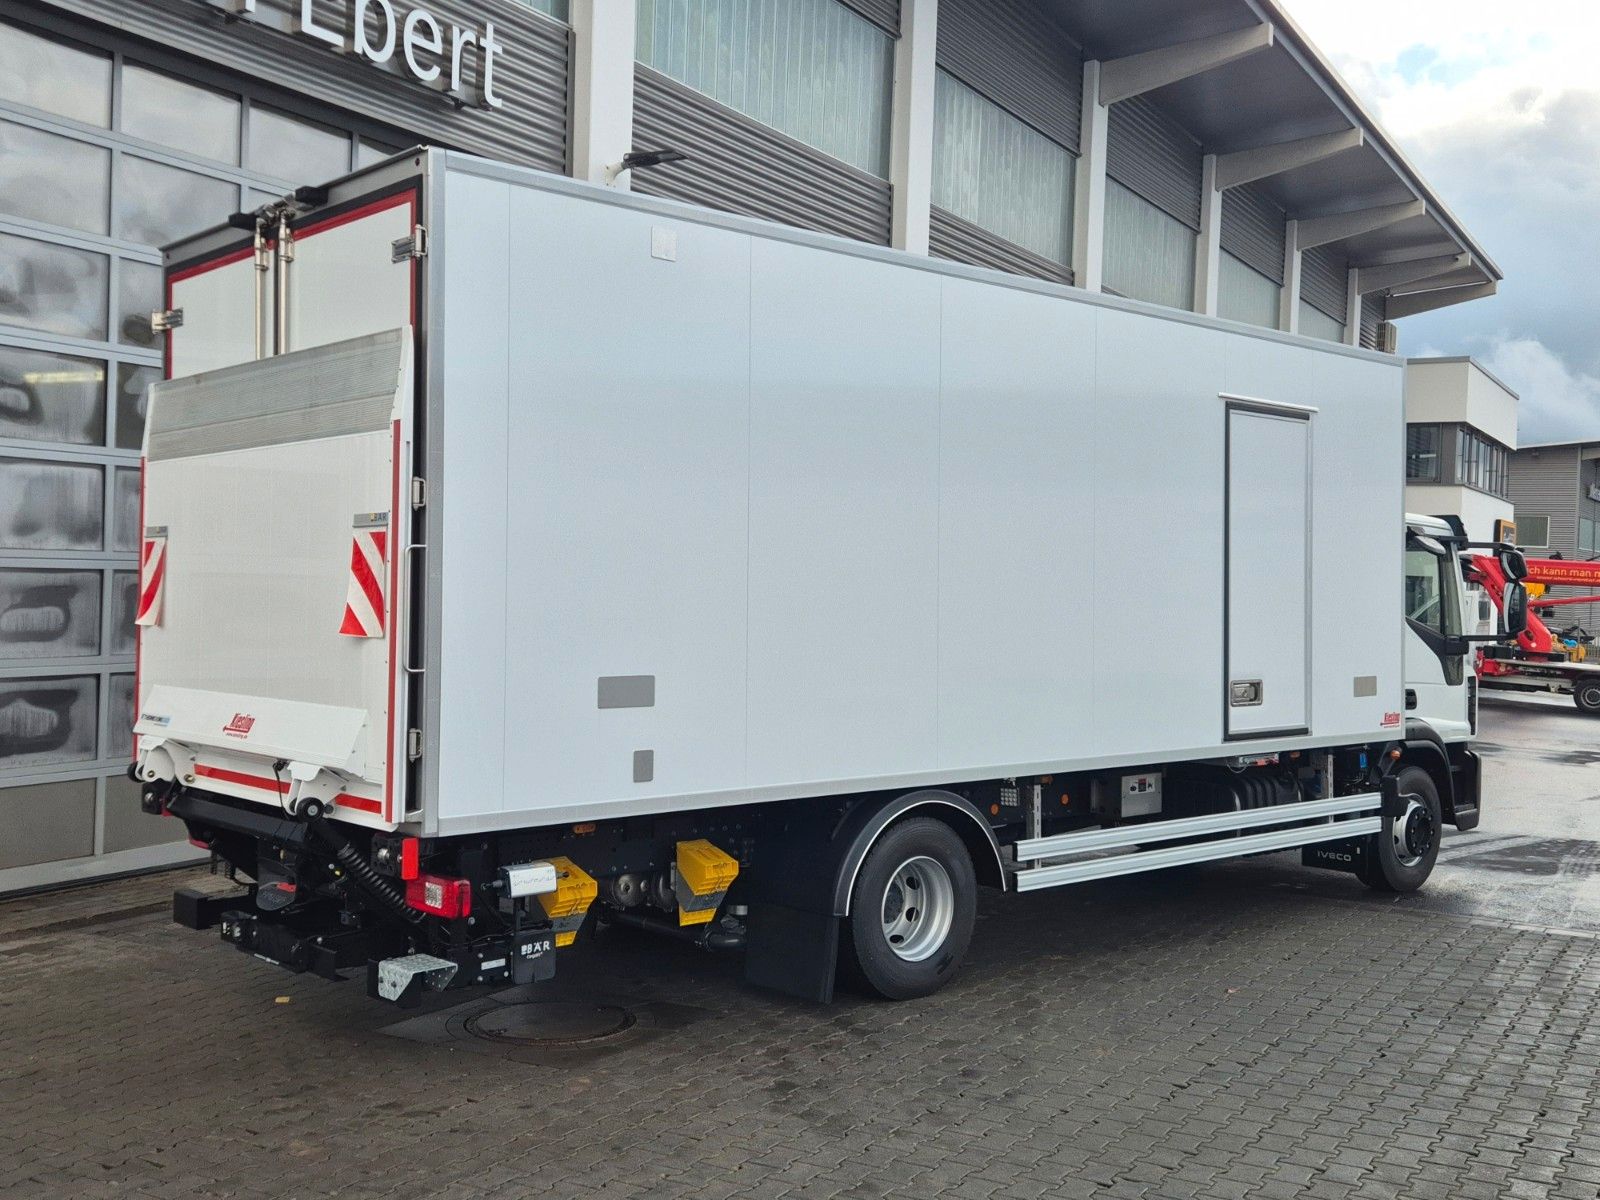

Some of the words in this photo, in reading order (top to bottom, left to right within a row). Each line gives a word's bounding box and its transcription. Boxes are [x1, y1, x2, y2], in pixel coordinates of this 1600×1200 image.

[1543, 566, 1567, 576] kann
[1569, 569, 1591, 577] man
[1317, 850, 1352, 862] IVECO
